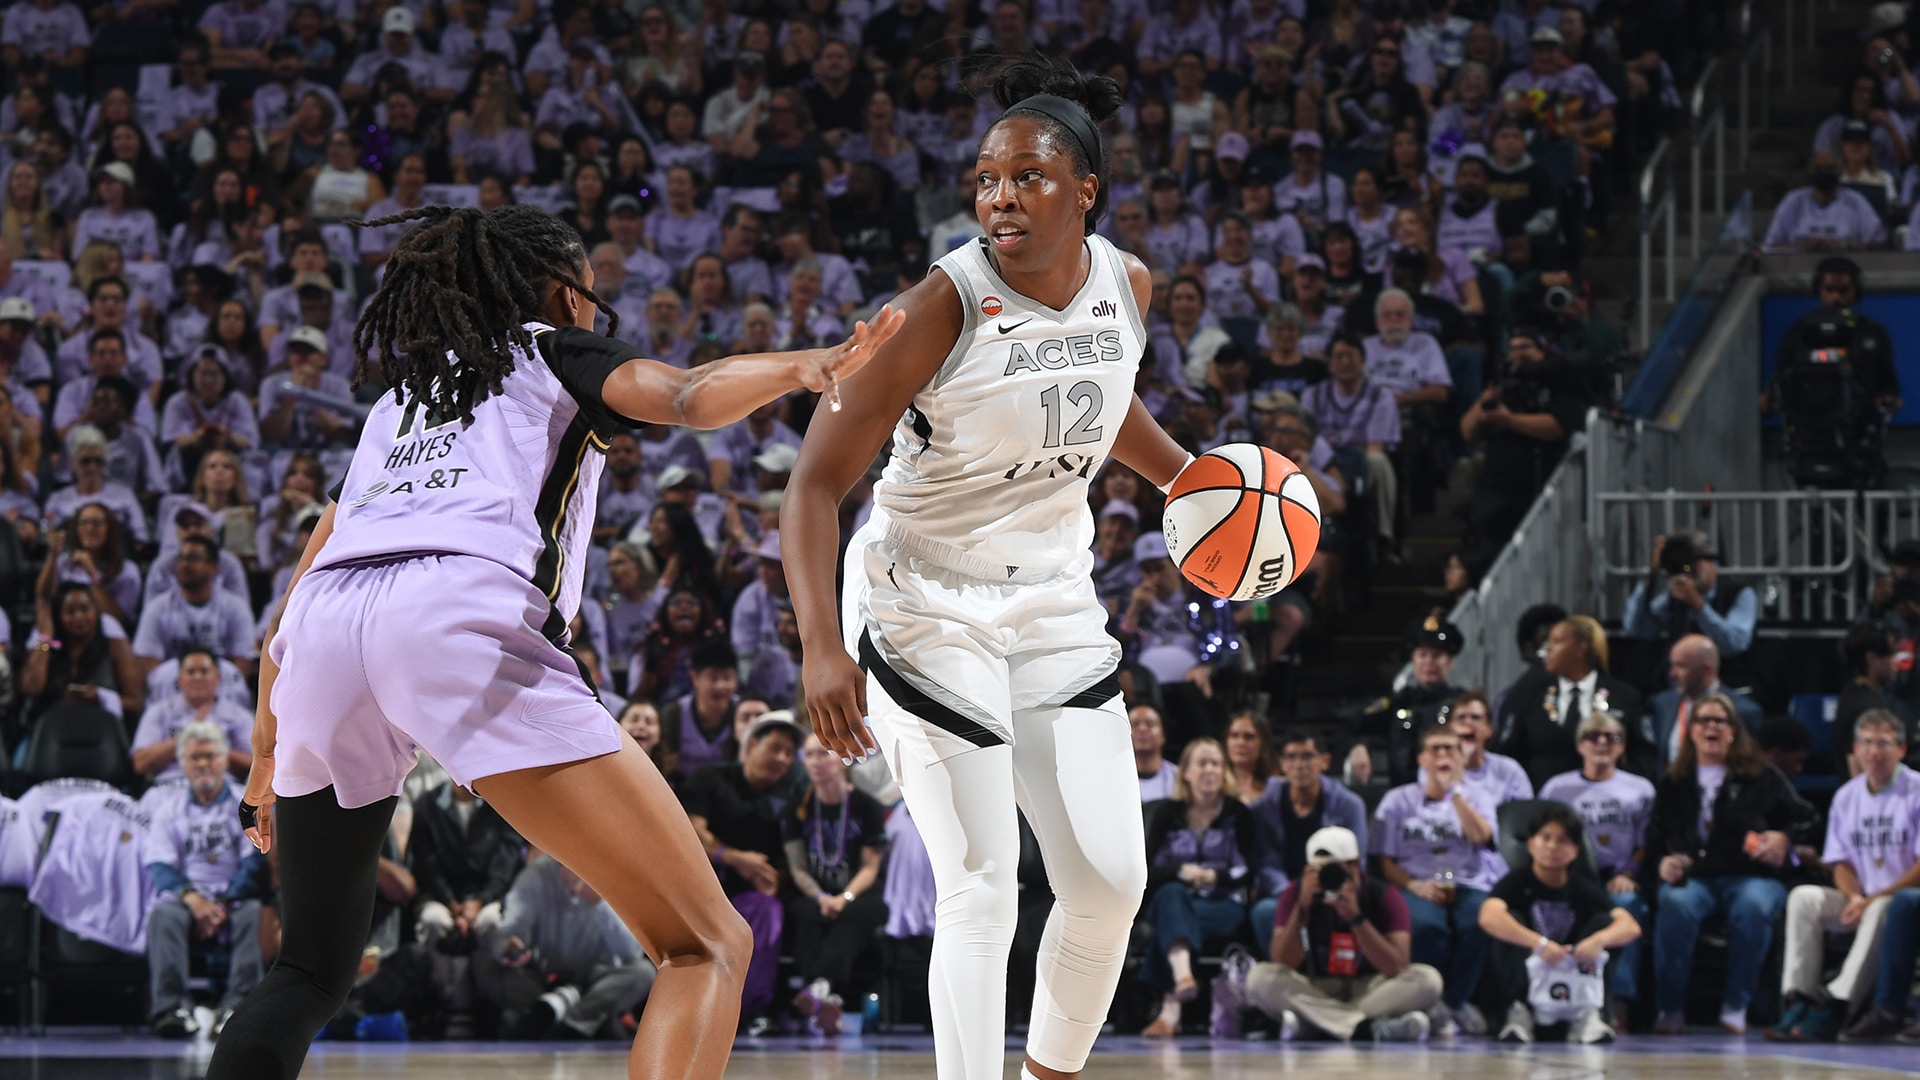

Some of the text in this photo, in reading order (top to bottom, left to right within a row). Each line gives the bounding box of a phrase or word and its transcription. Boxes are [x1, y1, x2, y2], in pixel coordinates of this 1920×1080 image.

[1091, 299, 1117, 319] ally
[1003, 329, 1124, 377] ACES
[1040, 380, 1104, 449] 12
[384, 431, 457, 470] HAYES
[389, 467, 469, 495] A&T
[1250, 553, 1285, 600] Wil
